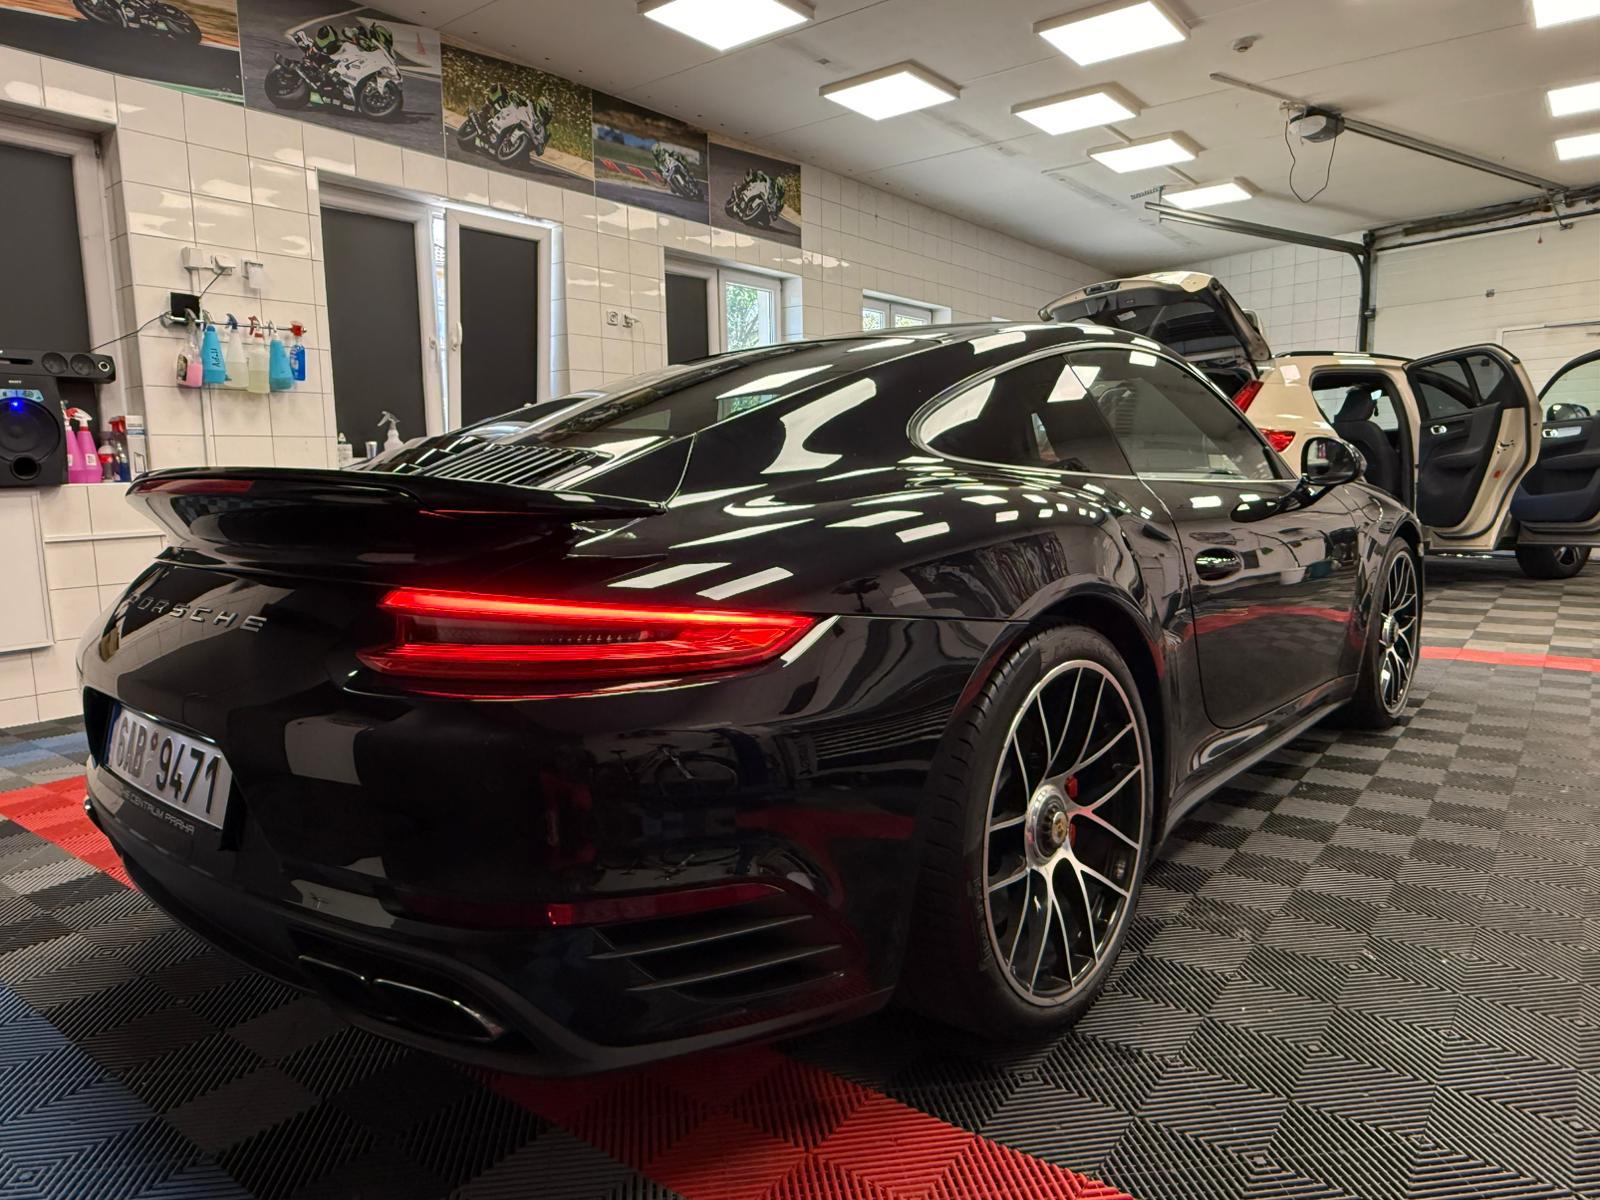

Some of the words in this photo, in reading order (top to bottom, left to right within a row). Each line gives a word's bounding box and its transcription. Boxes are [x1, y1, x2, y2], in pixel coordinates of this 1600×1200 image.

[116, 716, 147, 778] 6AB
[156, 735, 219, 814] 9471
[164, 812, 196, 836] PRAHA
